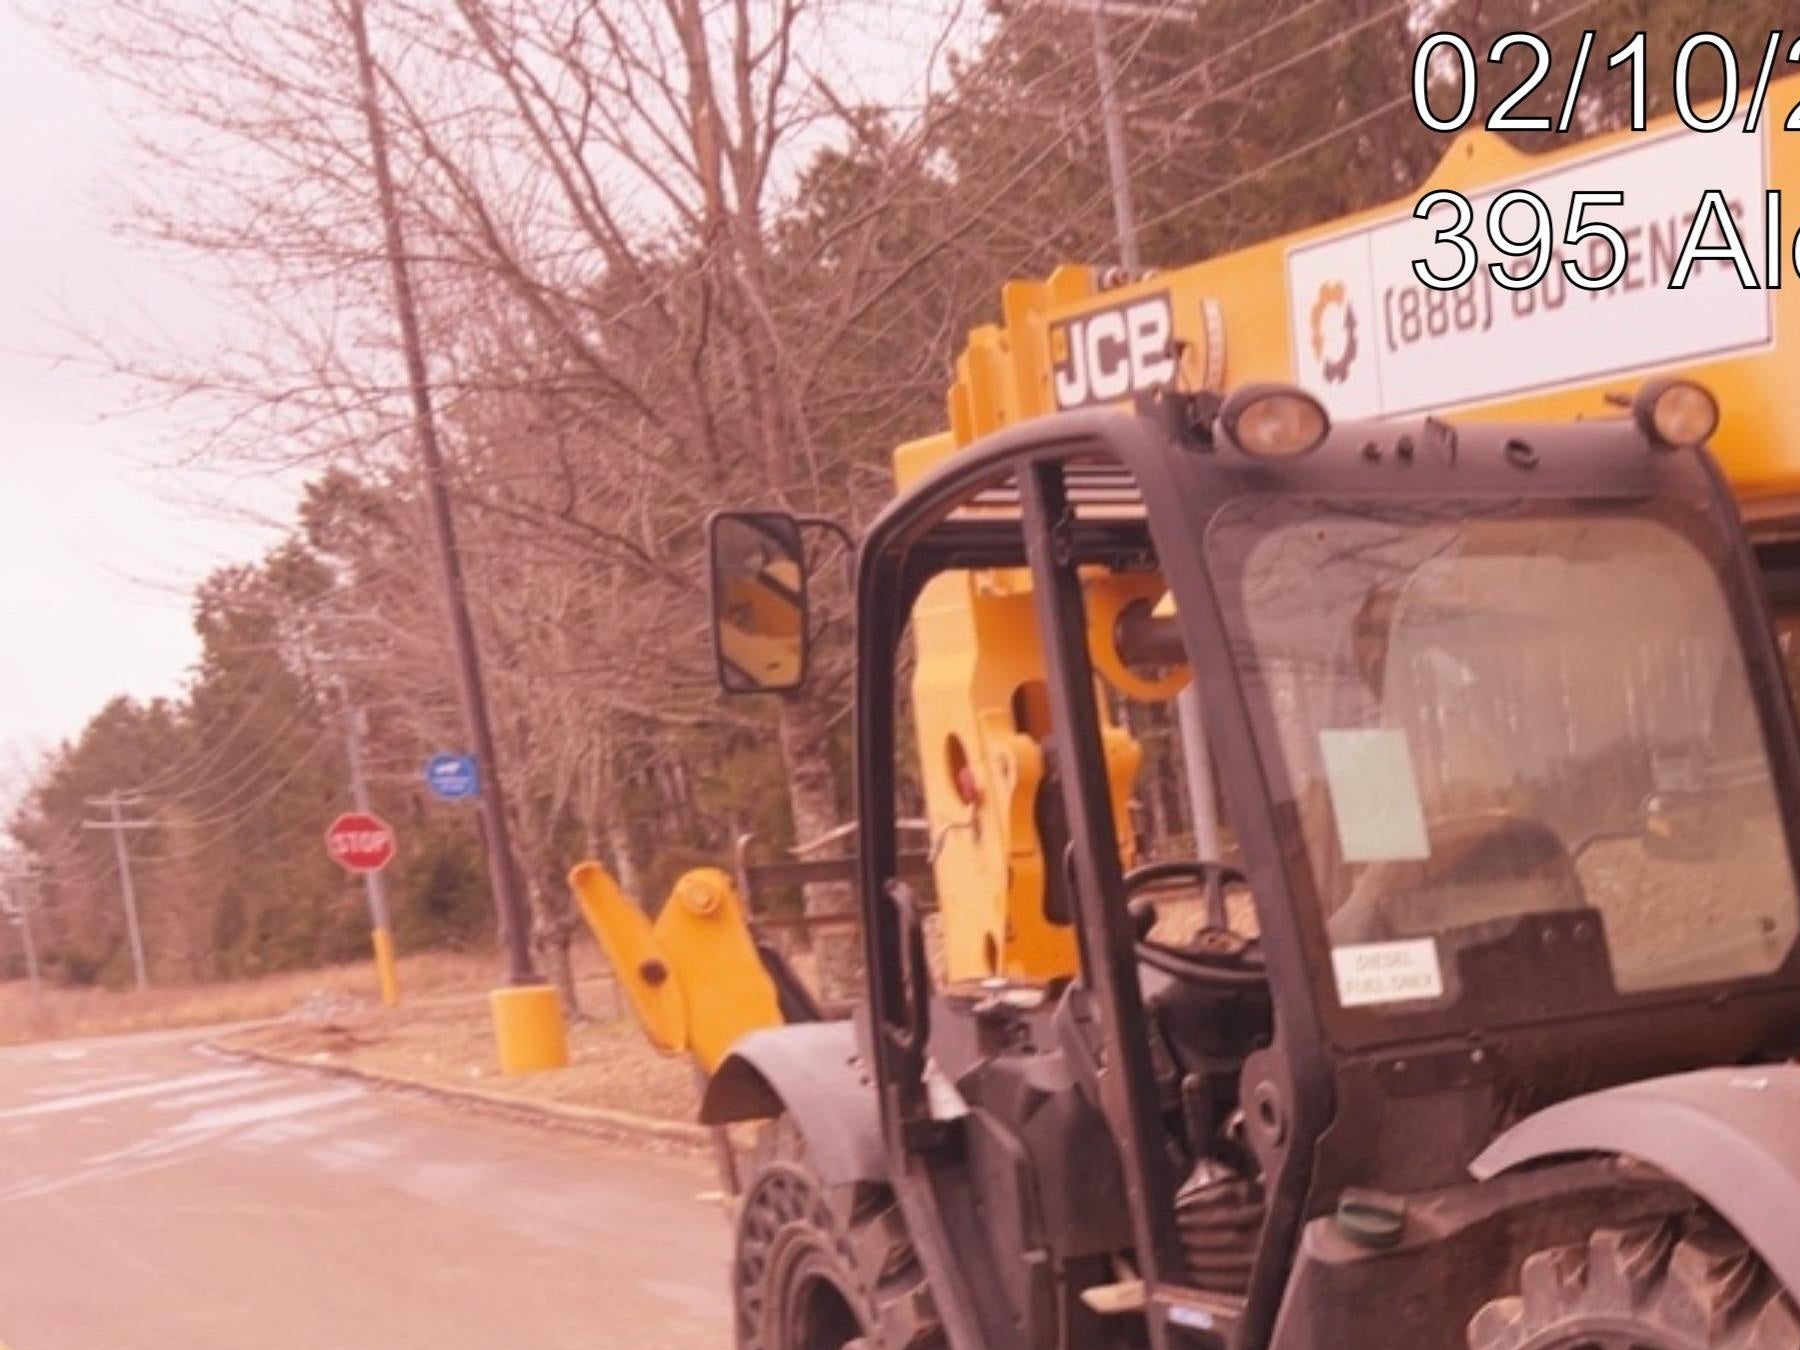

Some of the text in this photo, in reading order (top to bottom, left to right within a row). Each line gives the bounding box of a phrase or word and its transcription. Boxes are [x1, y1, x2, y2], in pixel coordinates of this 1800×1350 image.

[1509, 198, 1746, 319] 80RENS
[1054, 298, 1177, 408] JCB
[329, 830, 389, 855] STOP
